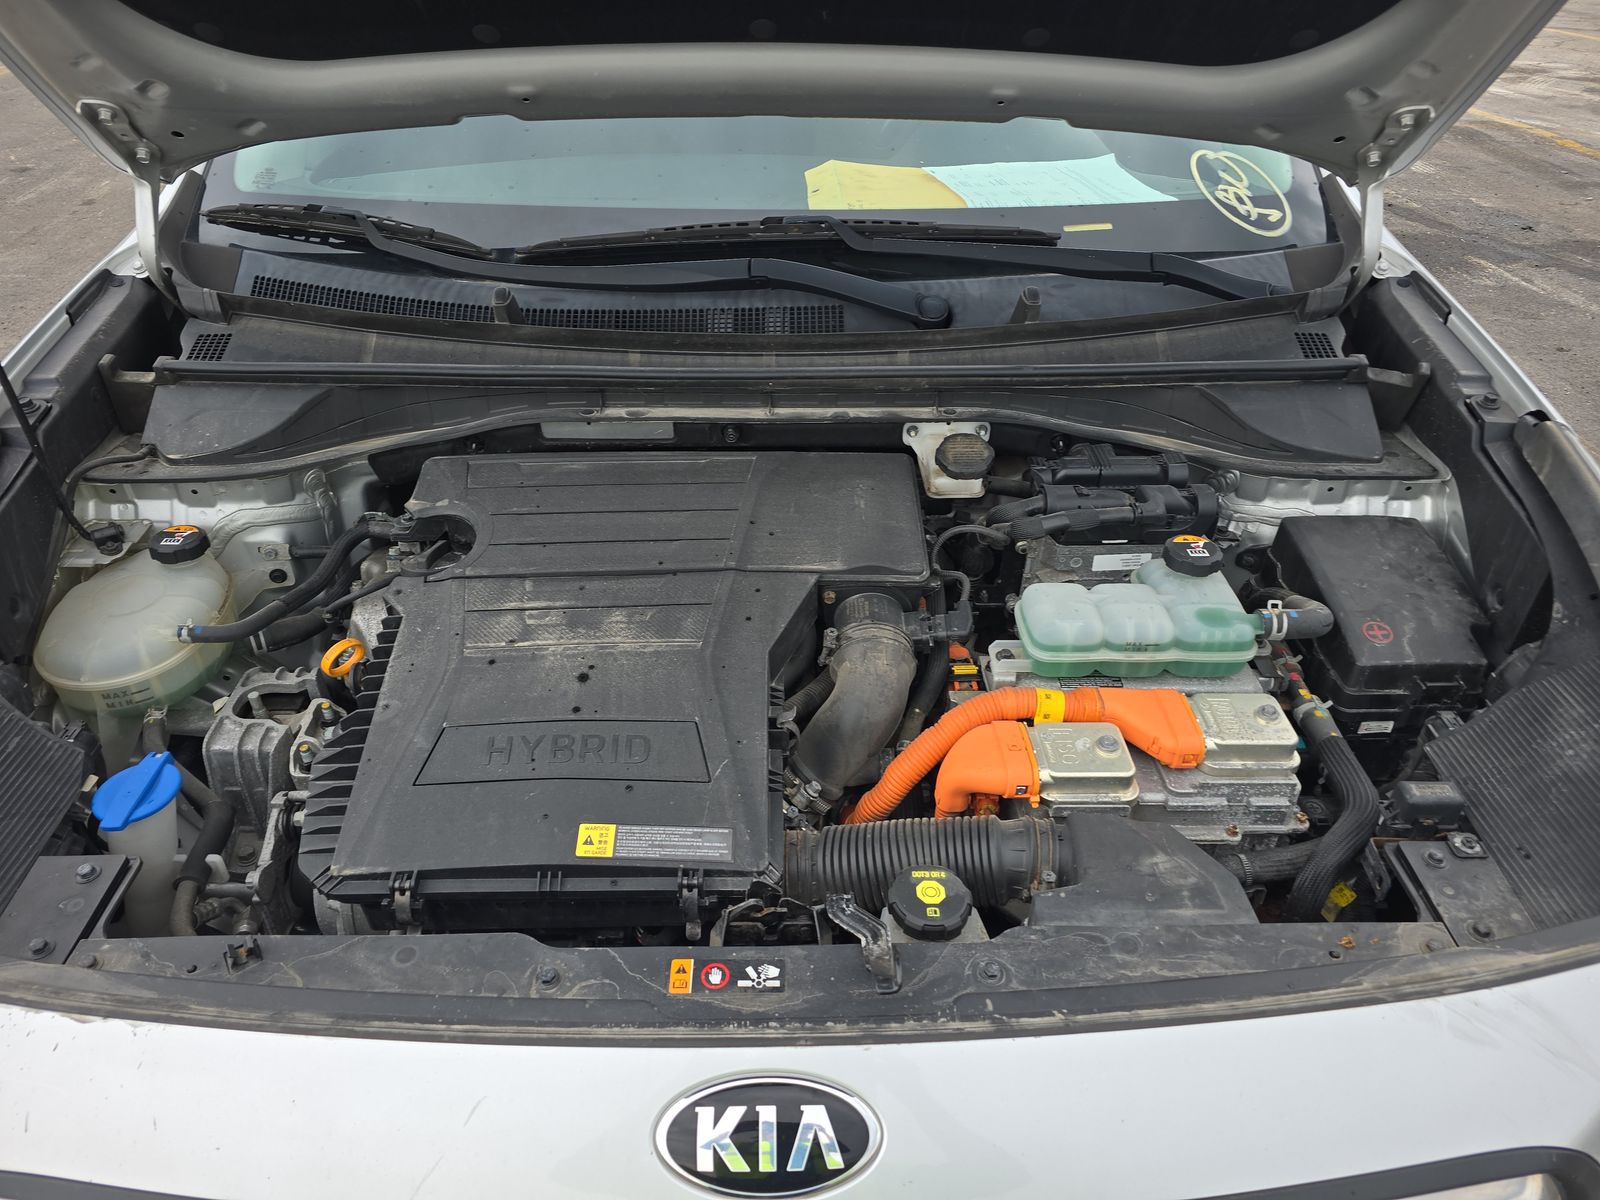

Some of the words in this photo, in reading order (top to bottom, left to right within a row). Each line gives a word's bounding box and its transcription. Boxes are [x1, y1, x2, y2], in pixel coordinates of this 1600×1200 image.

[101, 690, 130, 699] MAX
[481, 734, 651, 766] HYBRID
[695, 1104, 845, 1172] KIA
